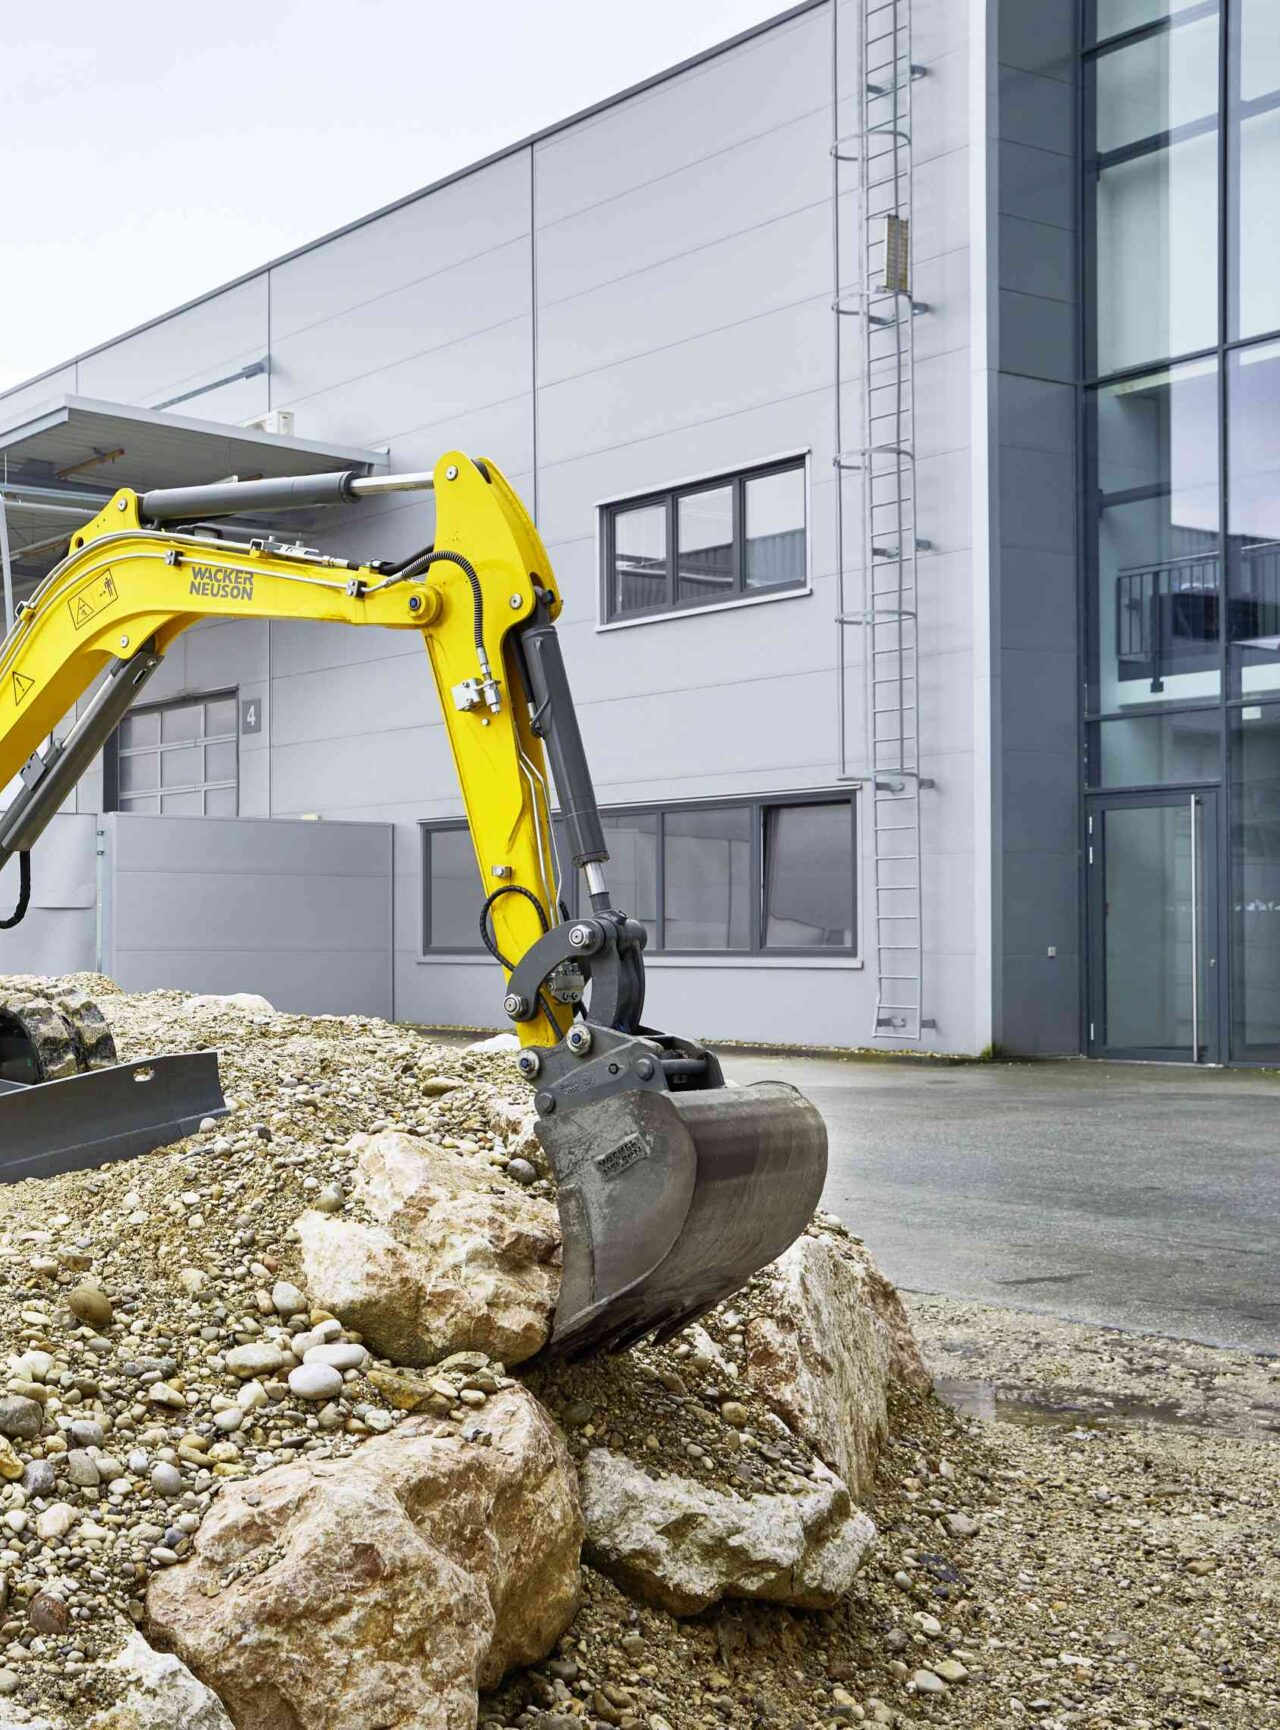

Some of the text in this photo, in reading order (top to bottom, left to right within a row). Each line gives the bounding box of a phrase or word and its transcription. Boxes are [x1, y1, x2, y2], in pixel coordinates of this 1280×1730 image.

[191, 566, 254, 586] WACKER
[189, 581, 254, 601] NEUSON
[246, 705, 256, 726] 4
